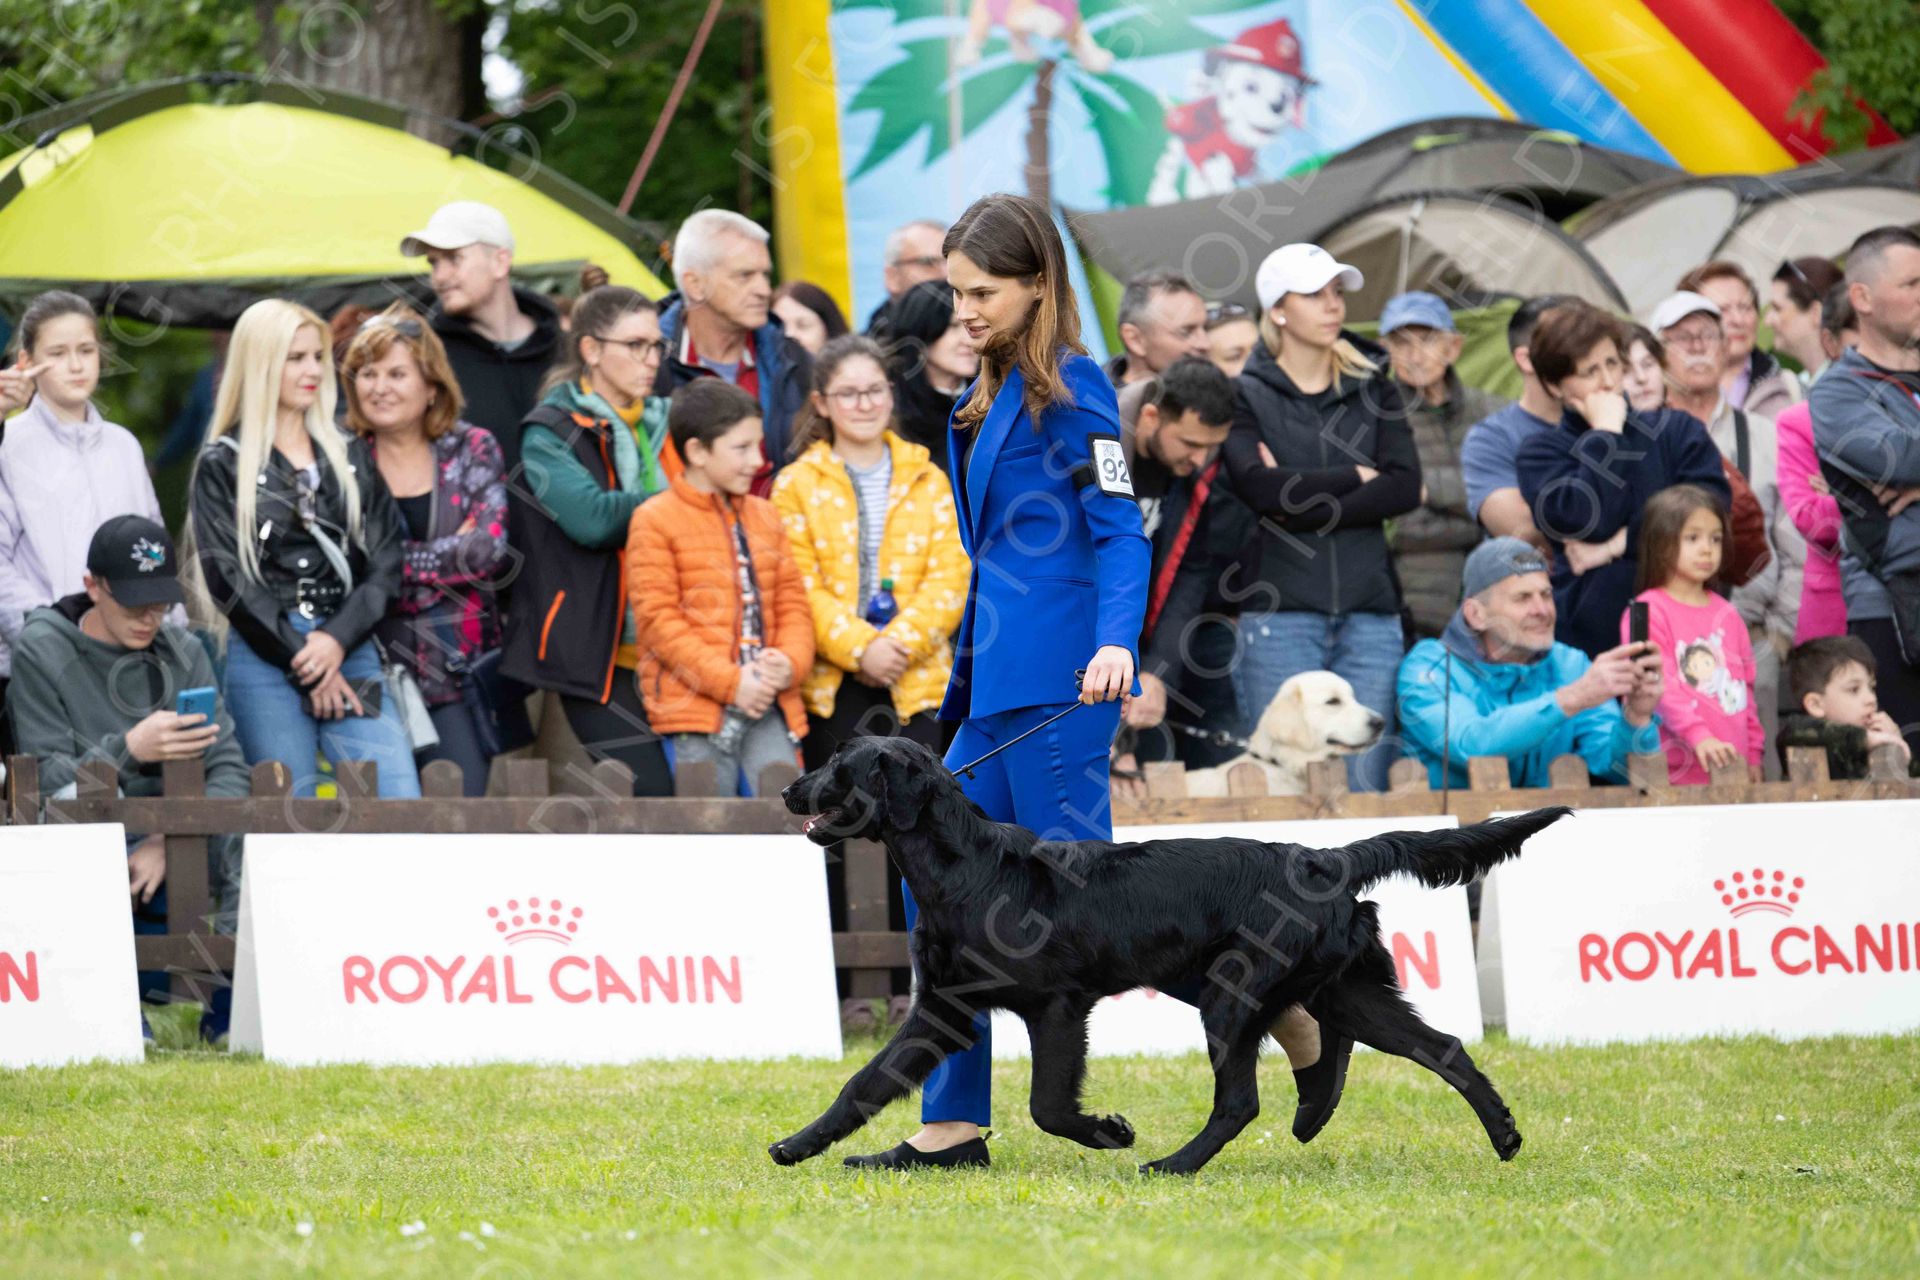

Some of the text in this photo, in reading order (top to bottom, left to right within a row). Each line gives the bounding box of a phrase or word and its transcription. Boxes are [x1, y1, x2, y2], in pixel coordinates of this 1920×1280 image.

[1102, 457, 1130, 484] 92
[1578, 921, 1920, 984] ROYAL CANI
[342, 954, 742, 1005] ROYAL CANIN
